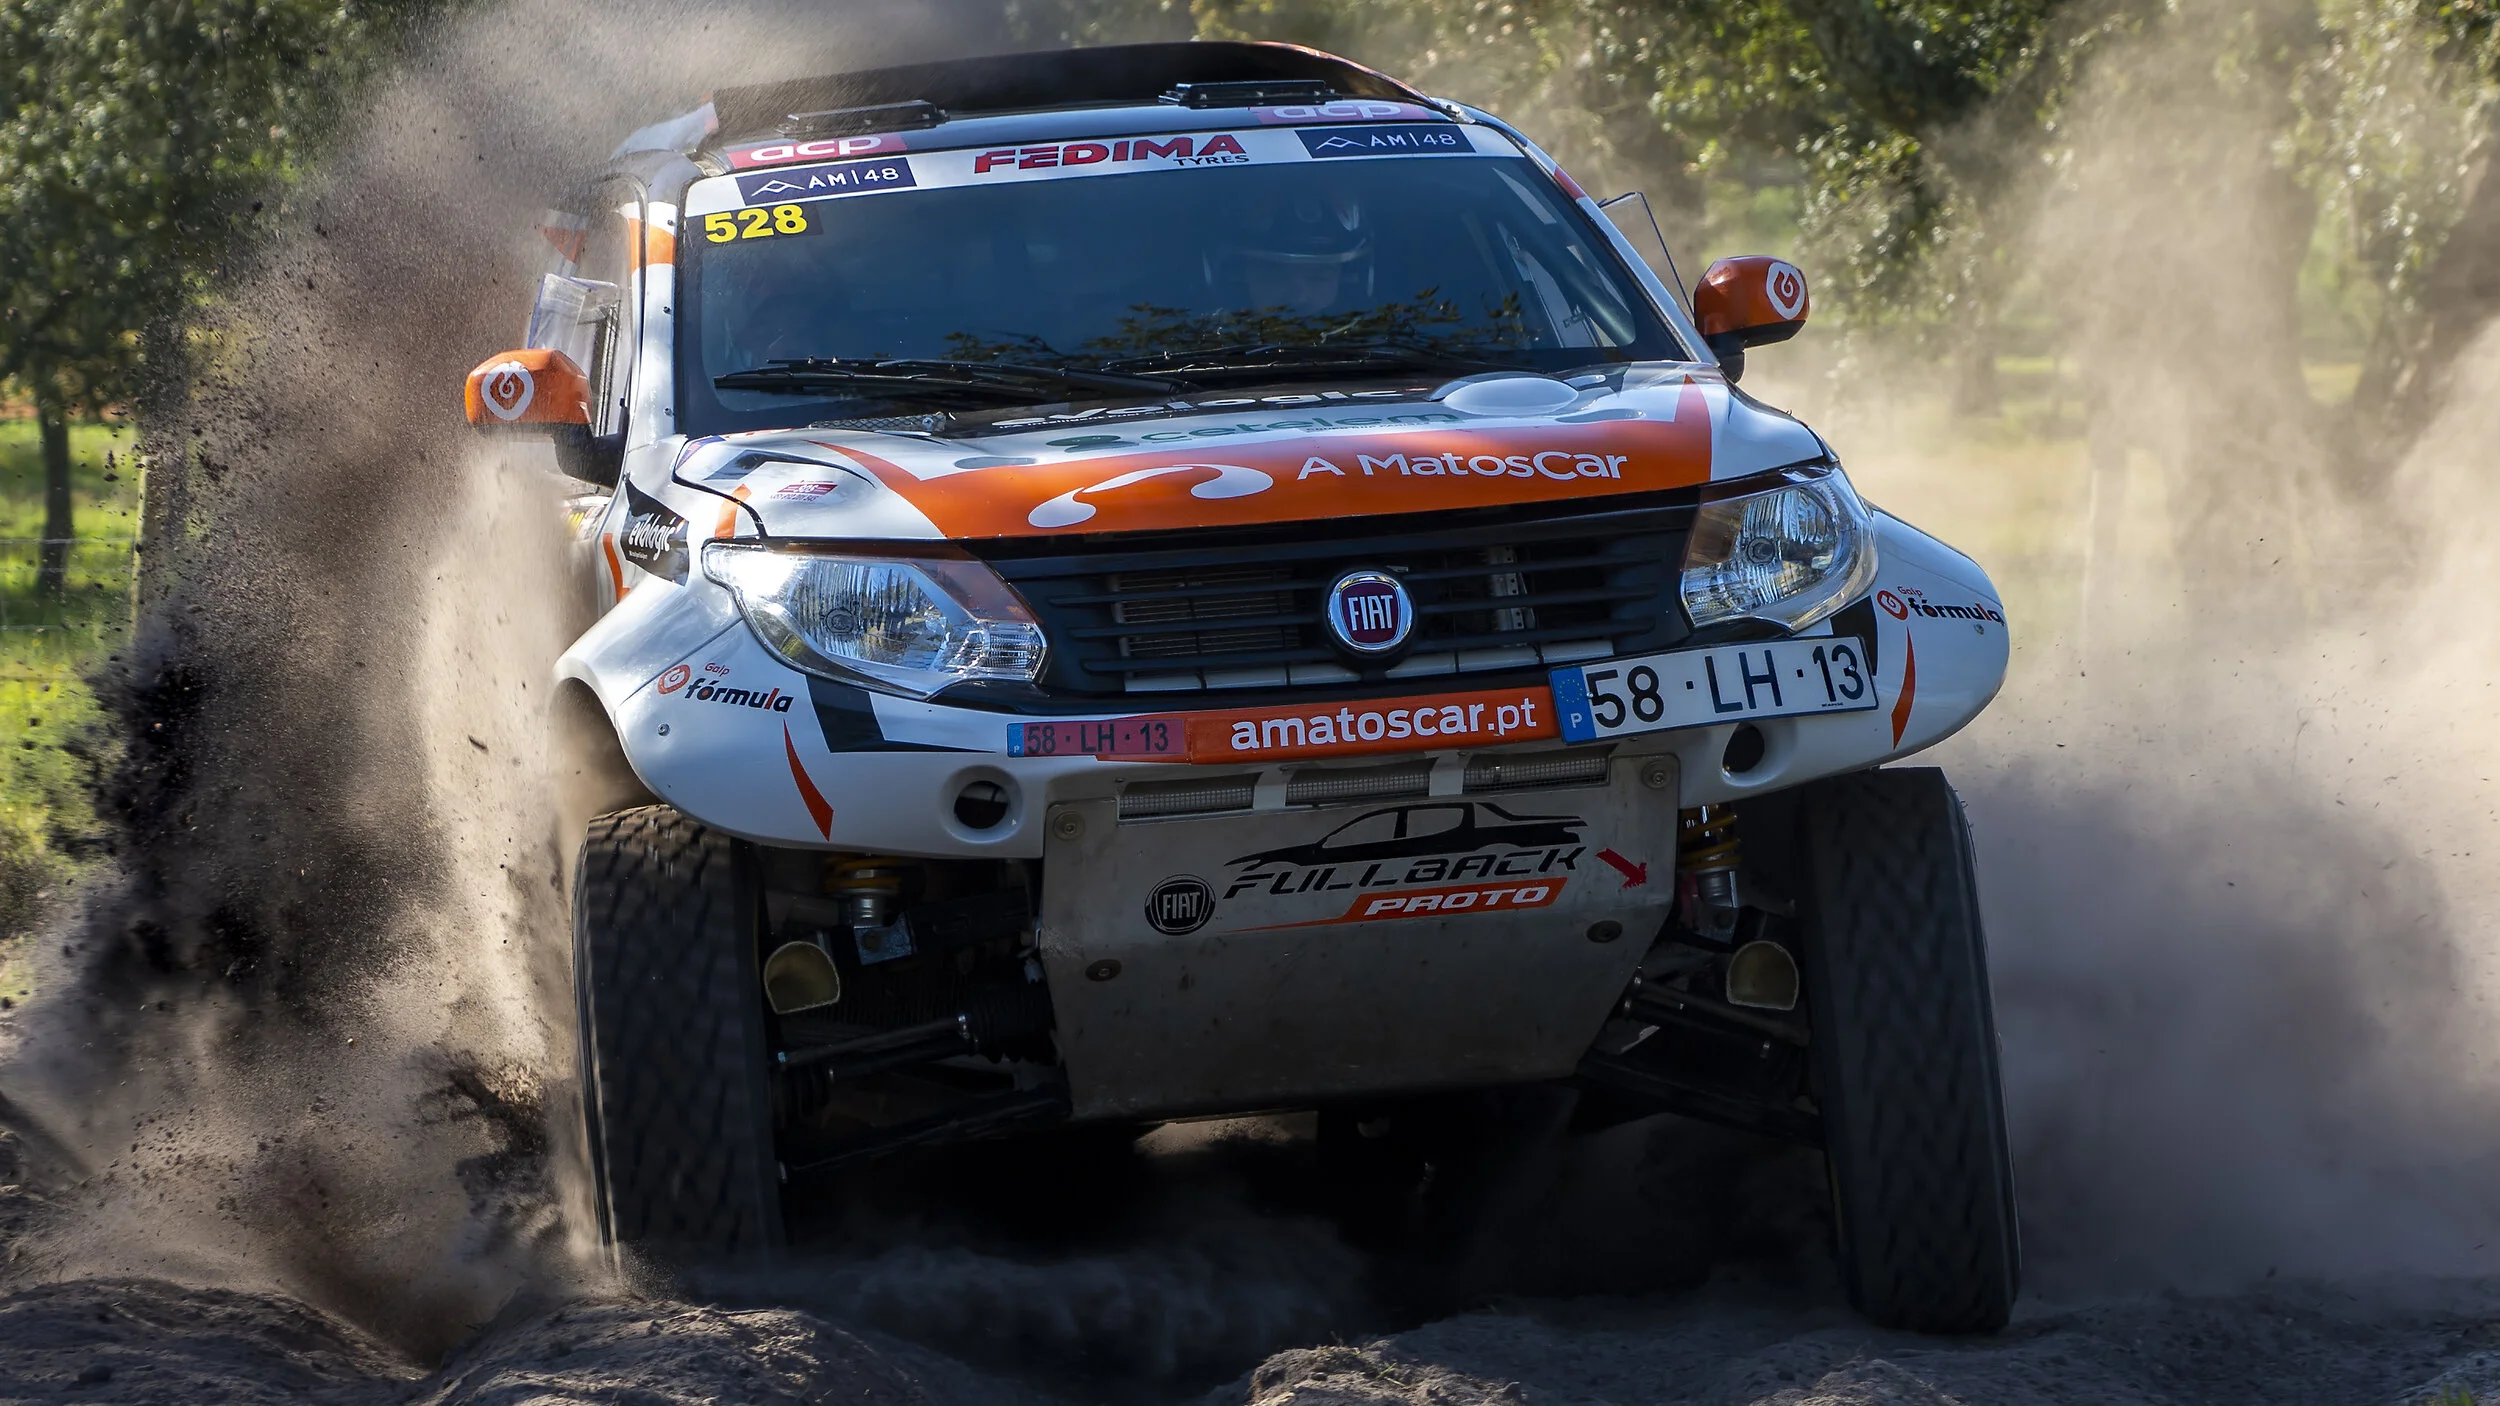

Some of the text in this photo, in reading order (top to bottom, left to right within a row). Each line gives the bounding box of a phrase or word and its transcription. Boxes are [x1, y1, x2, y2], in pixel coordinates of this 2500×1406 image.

[1273, 104, 1401, 119] acp
[750, 136, 882, 162] acp
[974, 134, 1247, 174] FEDIMA
[1173, 155, 1249, 167] TYRES
[704, 204, 808, 244] 528
[1141, 413, 1464, 443] cetelem
[1297, 450, 1628, 481] A MatosCar
[628, 513, 677, 561] evologic
[1897, 586, 1923, 598] Galp
[1347, 594, 1394, 631] FIAT
[704, 662, 731, 677] Galp
[684, 677, 795, 713] fórmula
[1570, 643, 1865, 729] P 58 LH 13
[1013, 722, 1170, 754] P 58 LH 13
[1231, 697, 1537, 751] amatoscar.pt
[1222, 846, 1587, 900] FULLBACK
[1161, 890, 1200, 920] FIAT
[1364, 886, 1548, 916] PROTO
